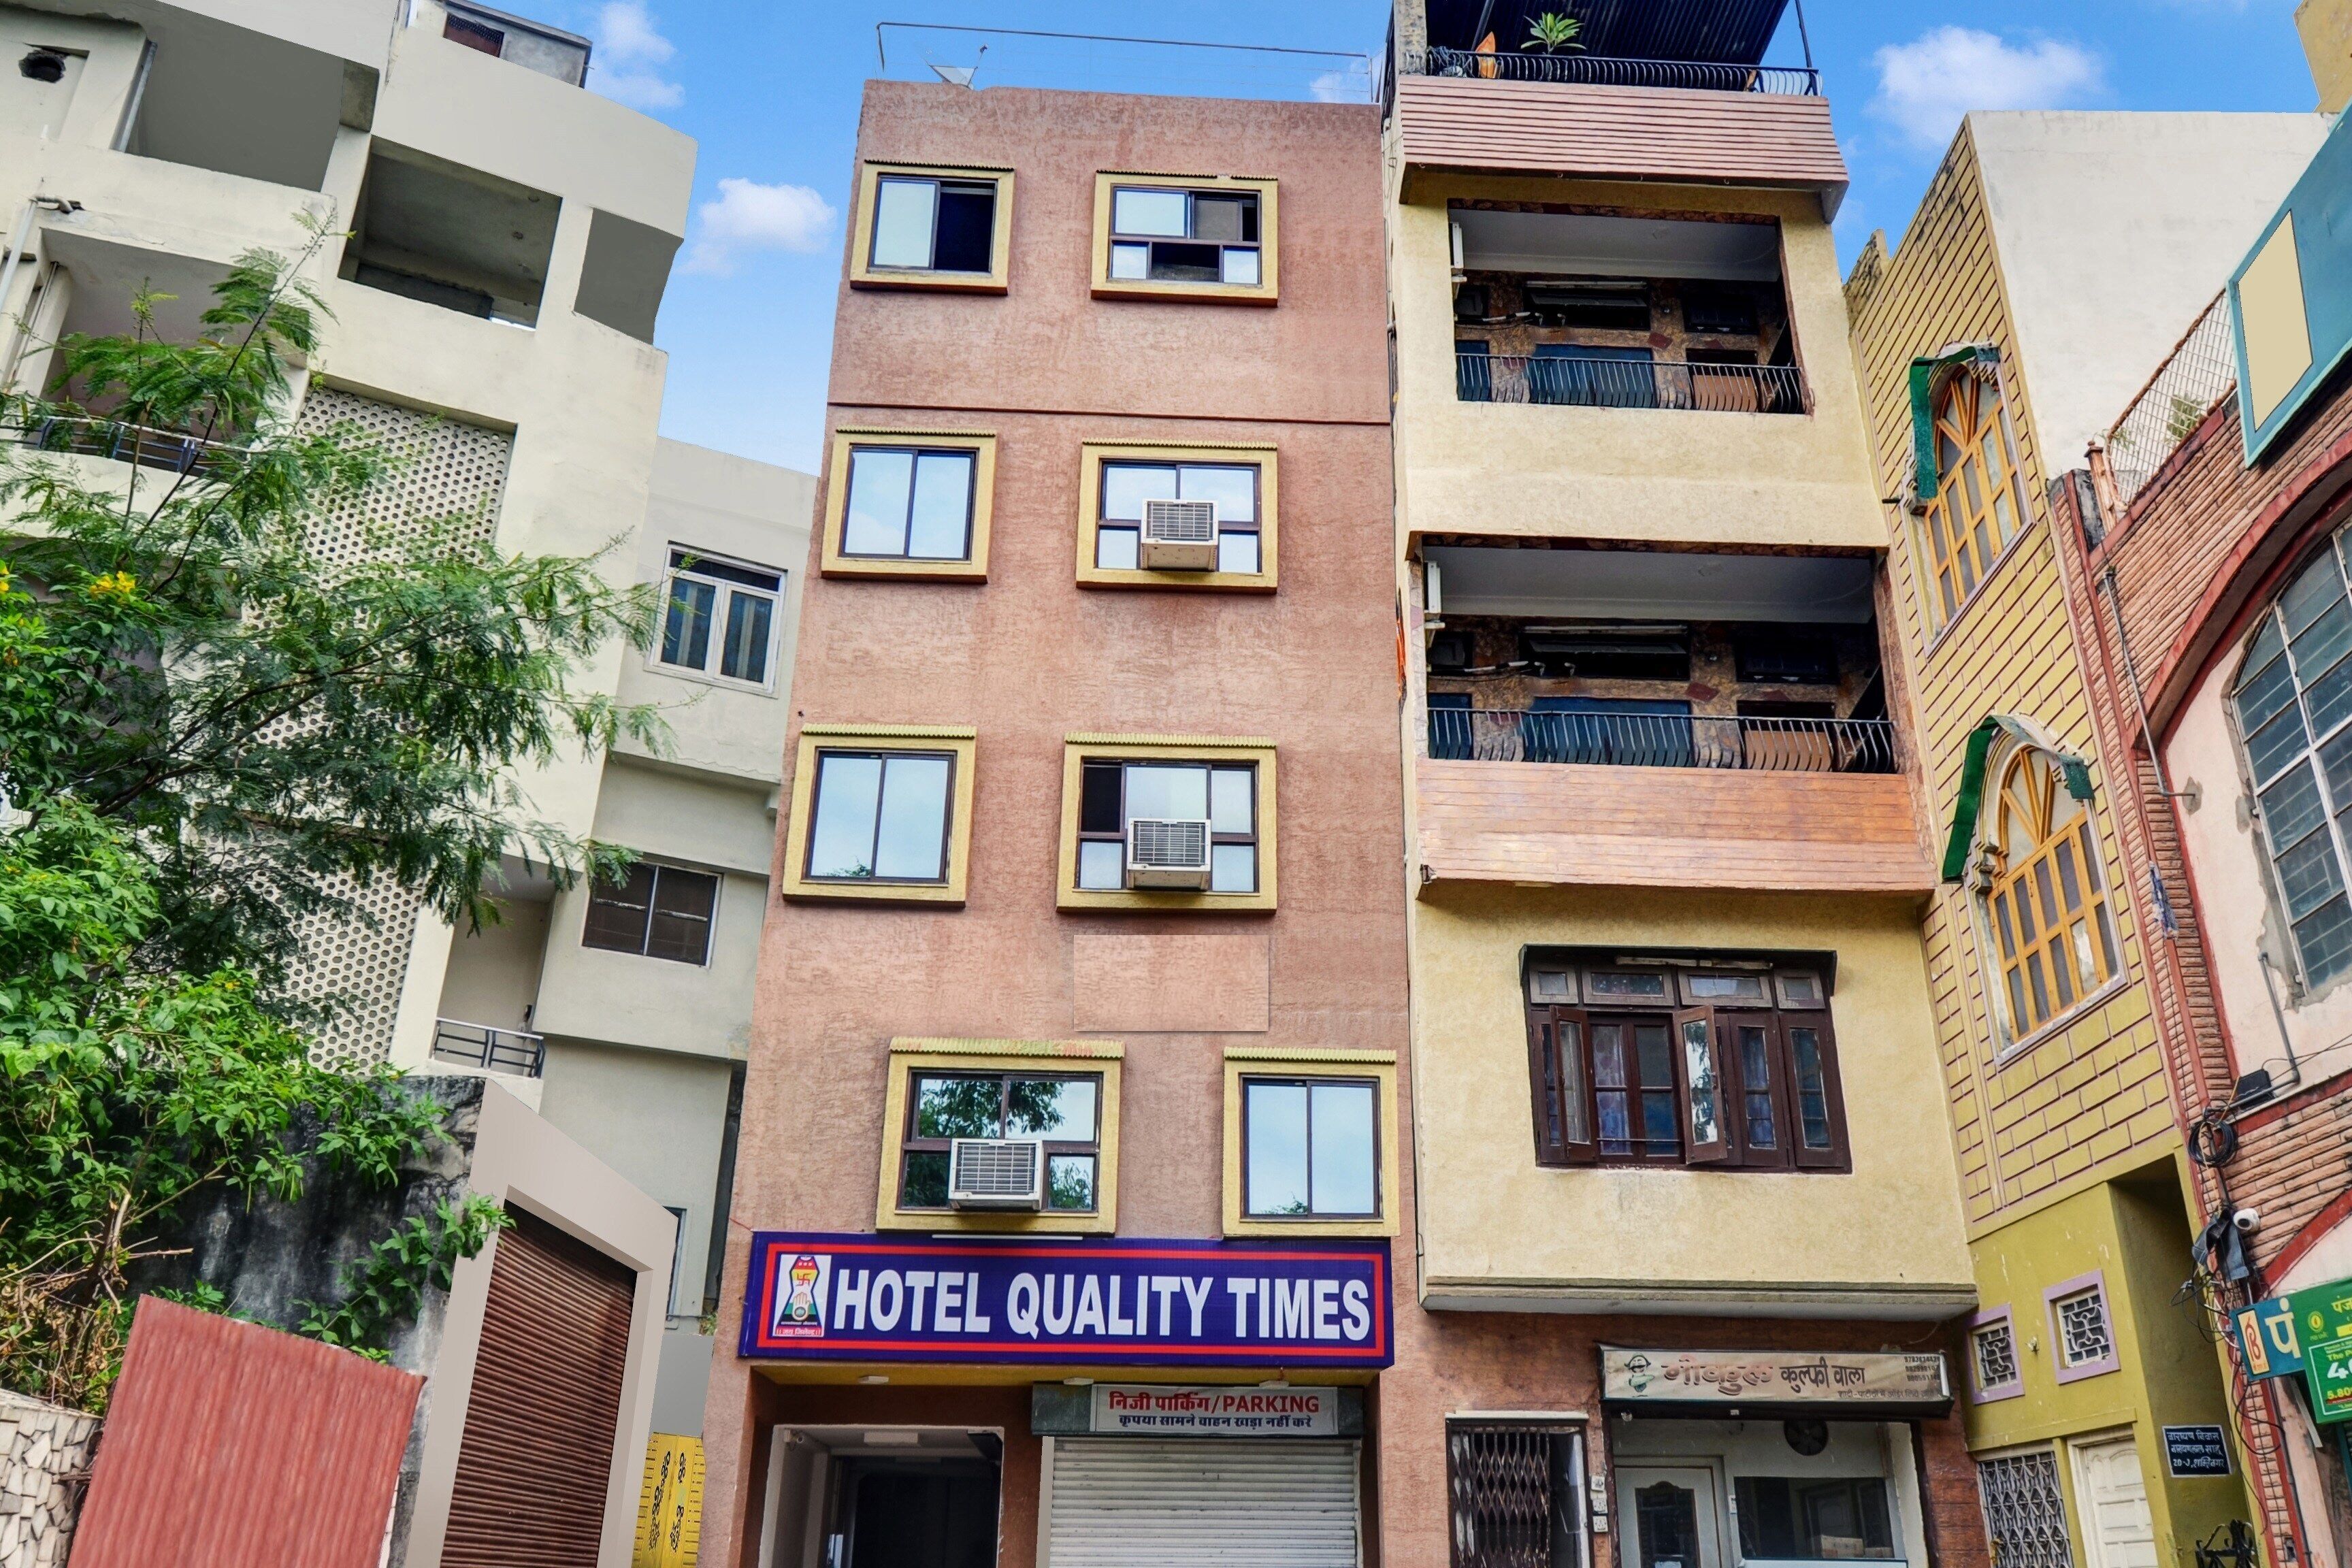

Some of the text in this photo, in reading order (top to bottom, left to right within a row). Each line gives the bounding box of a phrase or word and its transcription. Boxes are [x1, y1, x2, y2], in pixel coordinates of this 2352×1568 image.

[834, 1268, 1370, 1340] HOTEL QUALITY TIMES
[1779, 1356, 1831, 1394] कुल्फी
[1831, 1365, 1865, 1387] वाला
[2327, 1358, 2352, 1379] 4
[1109, 1390, 1151, 1410] निजी
[1119, 1413, 1312, 1430] कृपया सामने वाहन खड़ा नहीं करे
